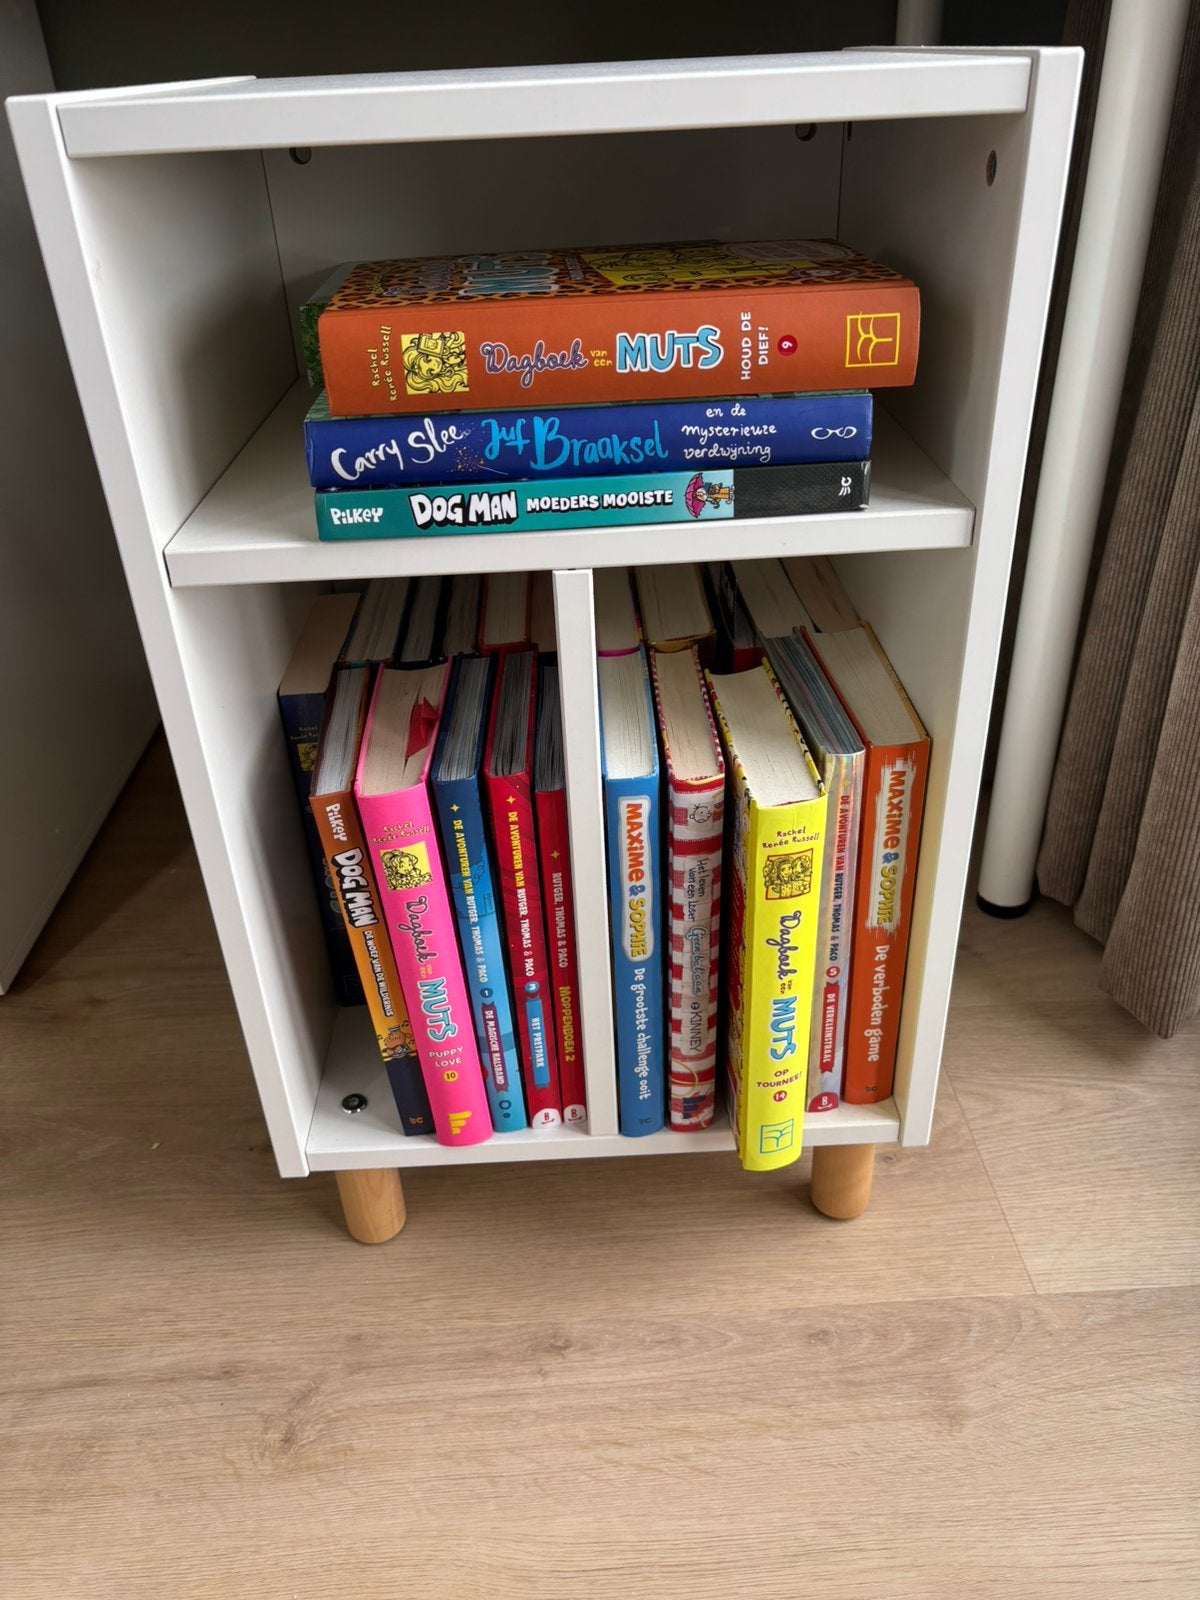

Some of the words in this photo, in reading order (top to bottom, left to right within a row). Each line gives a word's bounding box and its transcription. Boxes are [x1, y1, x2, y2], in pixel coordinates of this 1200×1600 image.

[741, 312, 752, 331] DE
[380, 325, 392, 366] Russell
[590, 349, 608, 358] van
[616, 325, 725, 373] MUTS
[758, 326, 769, 365] DIEF!
[367, 348, 380, 387] Rachel
[480, 338, 589, 388] Dagboek
[740, 337, 751, 380] HOUD
[706, 407, 723, 418] en
[731, 403, 746, 417] de
[331, 439, 404, 481] Carry
[407, 417, 465, 464] Slee
[480, 418, 530, 460] Juf
[530, 416, 669, 471] Braaksel
[409, 492, 463, 529] DOG
[468, 491, 518, 526] MAN
[526, 494, 599, 512] MOEDERS
[602, 489, 673, 508] MOOISTE
[840, 795, 850, 806] DE
[453, 819, 463, 830] DE
[508, 811, 518, 822] DE
[776, 825, 806, 838] Rachel
[835, 808, 849, 852] AVONTUREN
[510, 824, 523, 870] AVONTUREN
[761, 838, 790, 849] Renée
[791, 832, 820, 843] Russell
[455, 832, 470, 877] AVONTUREN
[834, 852, 845, 872] VAN
[881, 852, 899, 864] &
[331, 847, 368, 889] DOG
[463, 879, 473, 895] VAN
[515, 871, 524, 888] VAN
[629, 884, 646, 897] &
[345, 890, 379, 928] MAN
[831, 903, 842, 933] THOMAS
[398, 895, 438, 964] Dagboek
[554, 906, 567, 940] THOMAS
[363, 930, 374, 940] DE
[471, 926, 484, 955] THOMAS
[520, 919, 531, 949] THOMAS
[766, 909, 802, 980] Dagboek
[829, 943, 839, 962] PACO
[875, 944, 890, 961] De
[524, 958, 535, 977] PACO
[558, 949, 568, 968] PACO
[477, 964, 488, 983] PACO
[633, 967, 646, 981] De
[826, 993, 835, 1003] DE
[870, 967, 890, 1026] verboden
[418, 976, 457, 1042] MUTS
[484, 1010, 493, 1019] DE
[630, 983, 647, 1031] grootste
[531, 1017, 540, 1031] HET
[559, 985, 575, 1053] MOPPENBOEK
[768, 995, 798, 1061] MUTS
[690, 1011, 702, 1052] KINNEY
[428, 1047, 463, 1058] PUPPY
[532, 1032, 544, 1068] PRETPARK
[864, 1028, 883, 1062] game
[435, 1057, 462, 1067] LOVE
[565, 1054, 575, 1062] 2
[634, 1033, 652, 1078] challenge
[446, 1072, 456, 1080] 10
[756, 1071, 803, 1088] TOURNEE!
[774, 1068, 790, 1078] OP
[639, 1078, 652, 1100] ooit
[775, 1092, 785, 1101] 14
